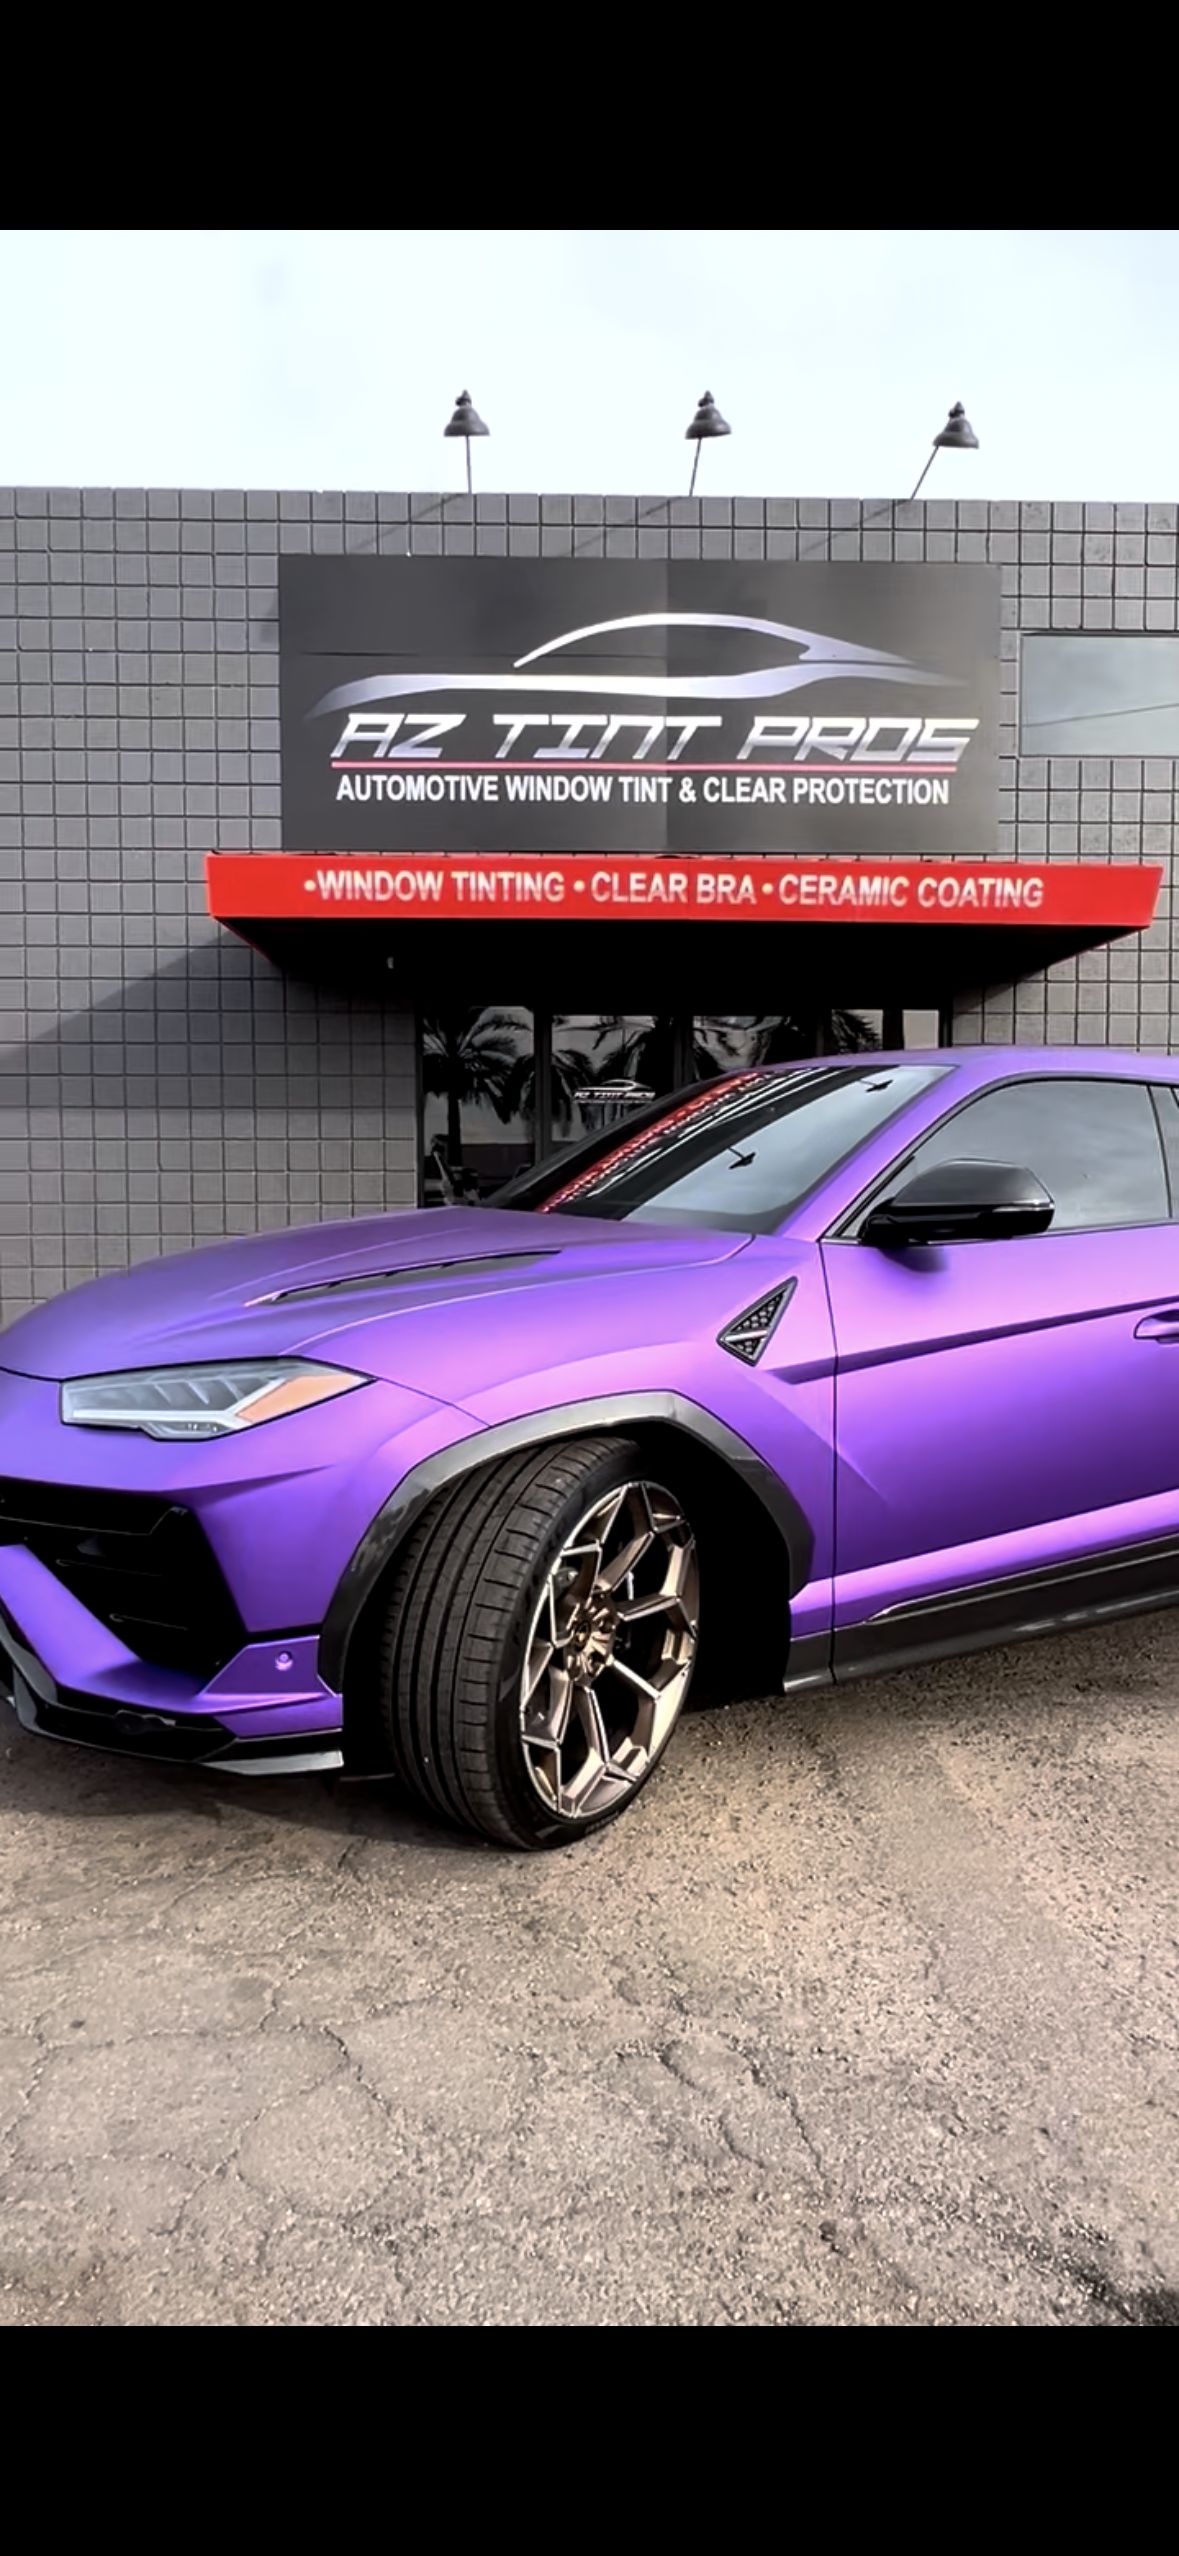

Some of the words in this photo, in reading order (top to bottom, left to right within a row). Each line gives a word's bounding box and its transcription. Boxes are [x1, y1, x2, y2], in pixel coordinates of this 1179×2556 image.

[331, 713, 467, 759] AZ
[493, 714, 723, 760] TINT
[736, 716, 980, 764] PROS
[335, 774, 499, 801] AUTOMOTIVE
[504, 774, 614, 802] WINDOW
[617, 775, 674, 803] TINT
[678, 776, 697, 803] &
[703, 776, 788, 804] CLEAR
[792, 777, 950, 805] PROTECTION
[450, 870, 565, 902] TINTING
[591, 871, 688, 903] CLEAR
[696, 872, 757, 904] BRA
[778, 873, 910, 907] CERAMIC
[917, 876, 1044, 908] COATING
